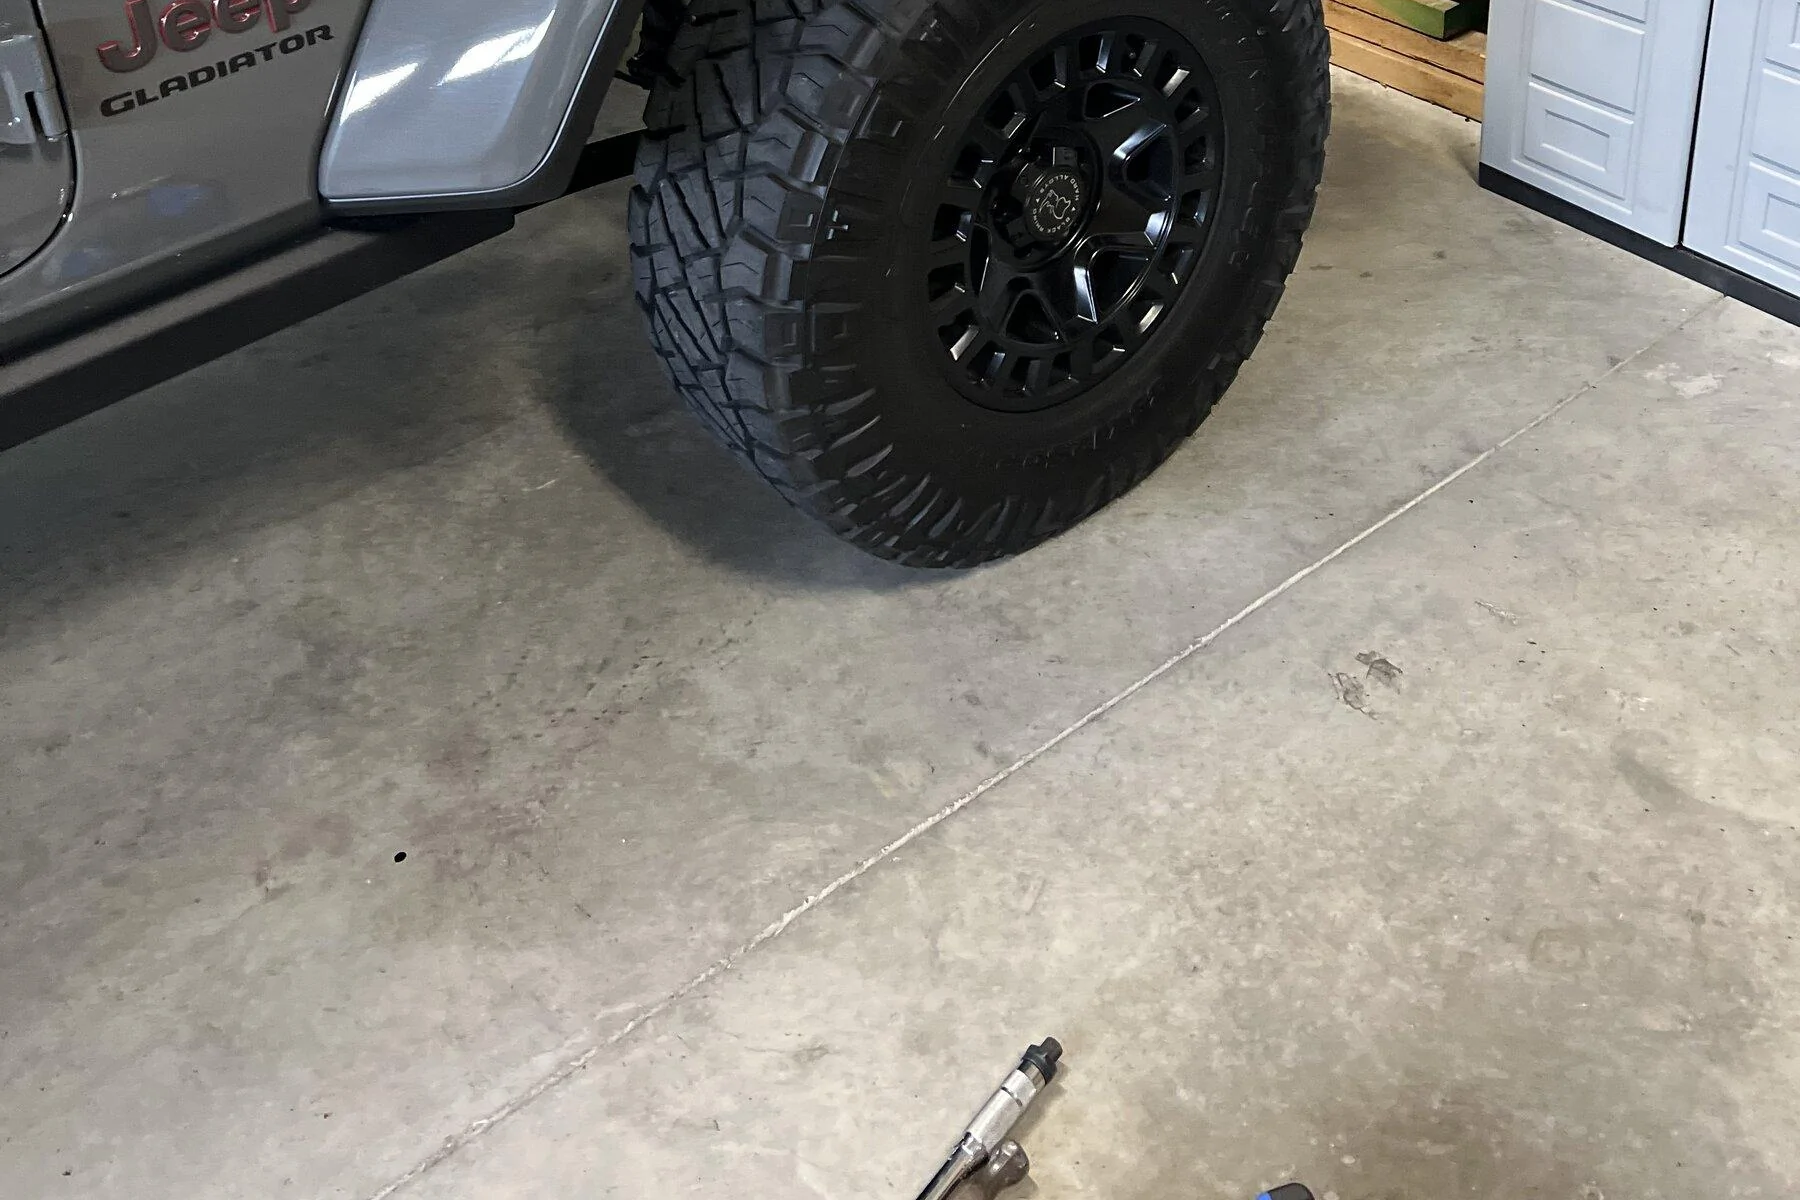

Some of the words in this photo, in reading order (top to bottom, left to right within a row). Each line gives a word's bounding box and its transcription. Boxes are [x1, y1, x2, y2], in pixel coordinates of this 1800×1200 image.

[100, 24, 335, 117] GLADIATOR
[1040, 175, 1069, 193] ALLOYS
[1070, 178, 1080, 201] HARD
[1032, 208, 1045, 232] RHINO
[1047, 217, 1070, 233] BLACK
